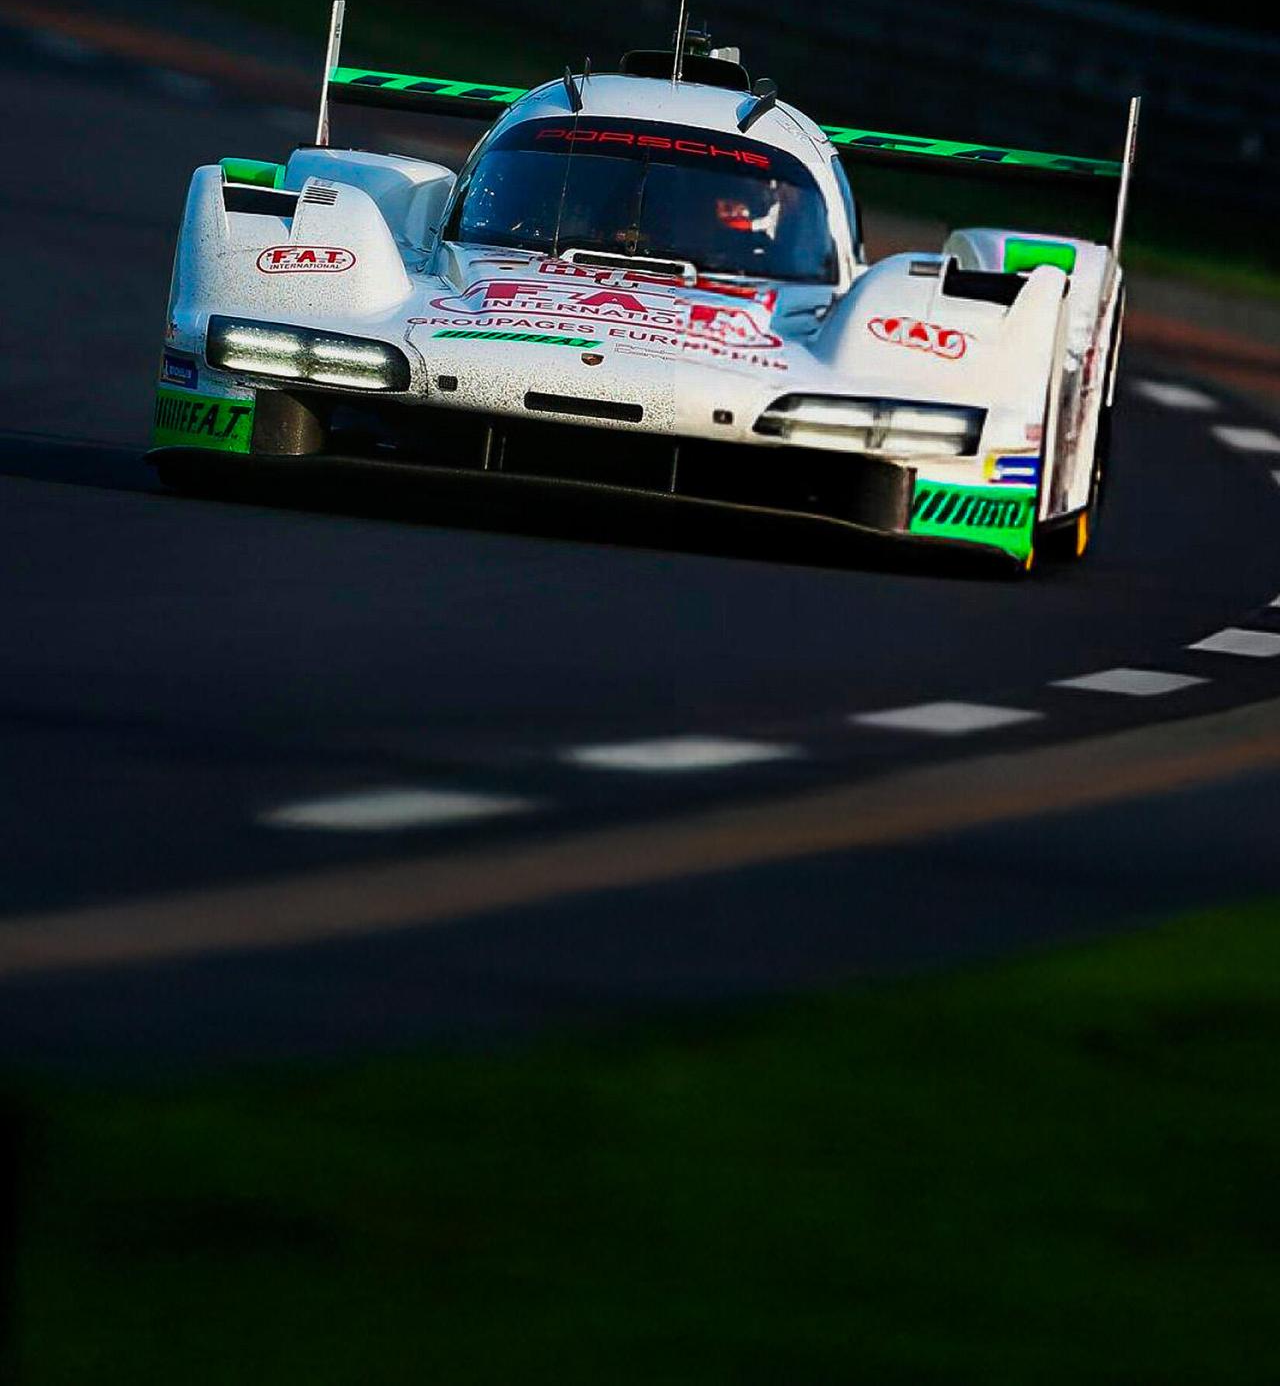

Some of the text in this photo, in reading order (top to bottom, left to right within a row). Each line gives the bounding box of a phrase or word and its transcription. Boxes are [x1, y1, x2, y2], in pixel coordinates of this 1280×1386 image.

[536, 129, 770, 169] PORSCHE
[269, 262, 341, 270] INTERNATIONAL
[406, 317, 595, 334] GROUPAGES
